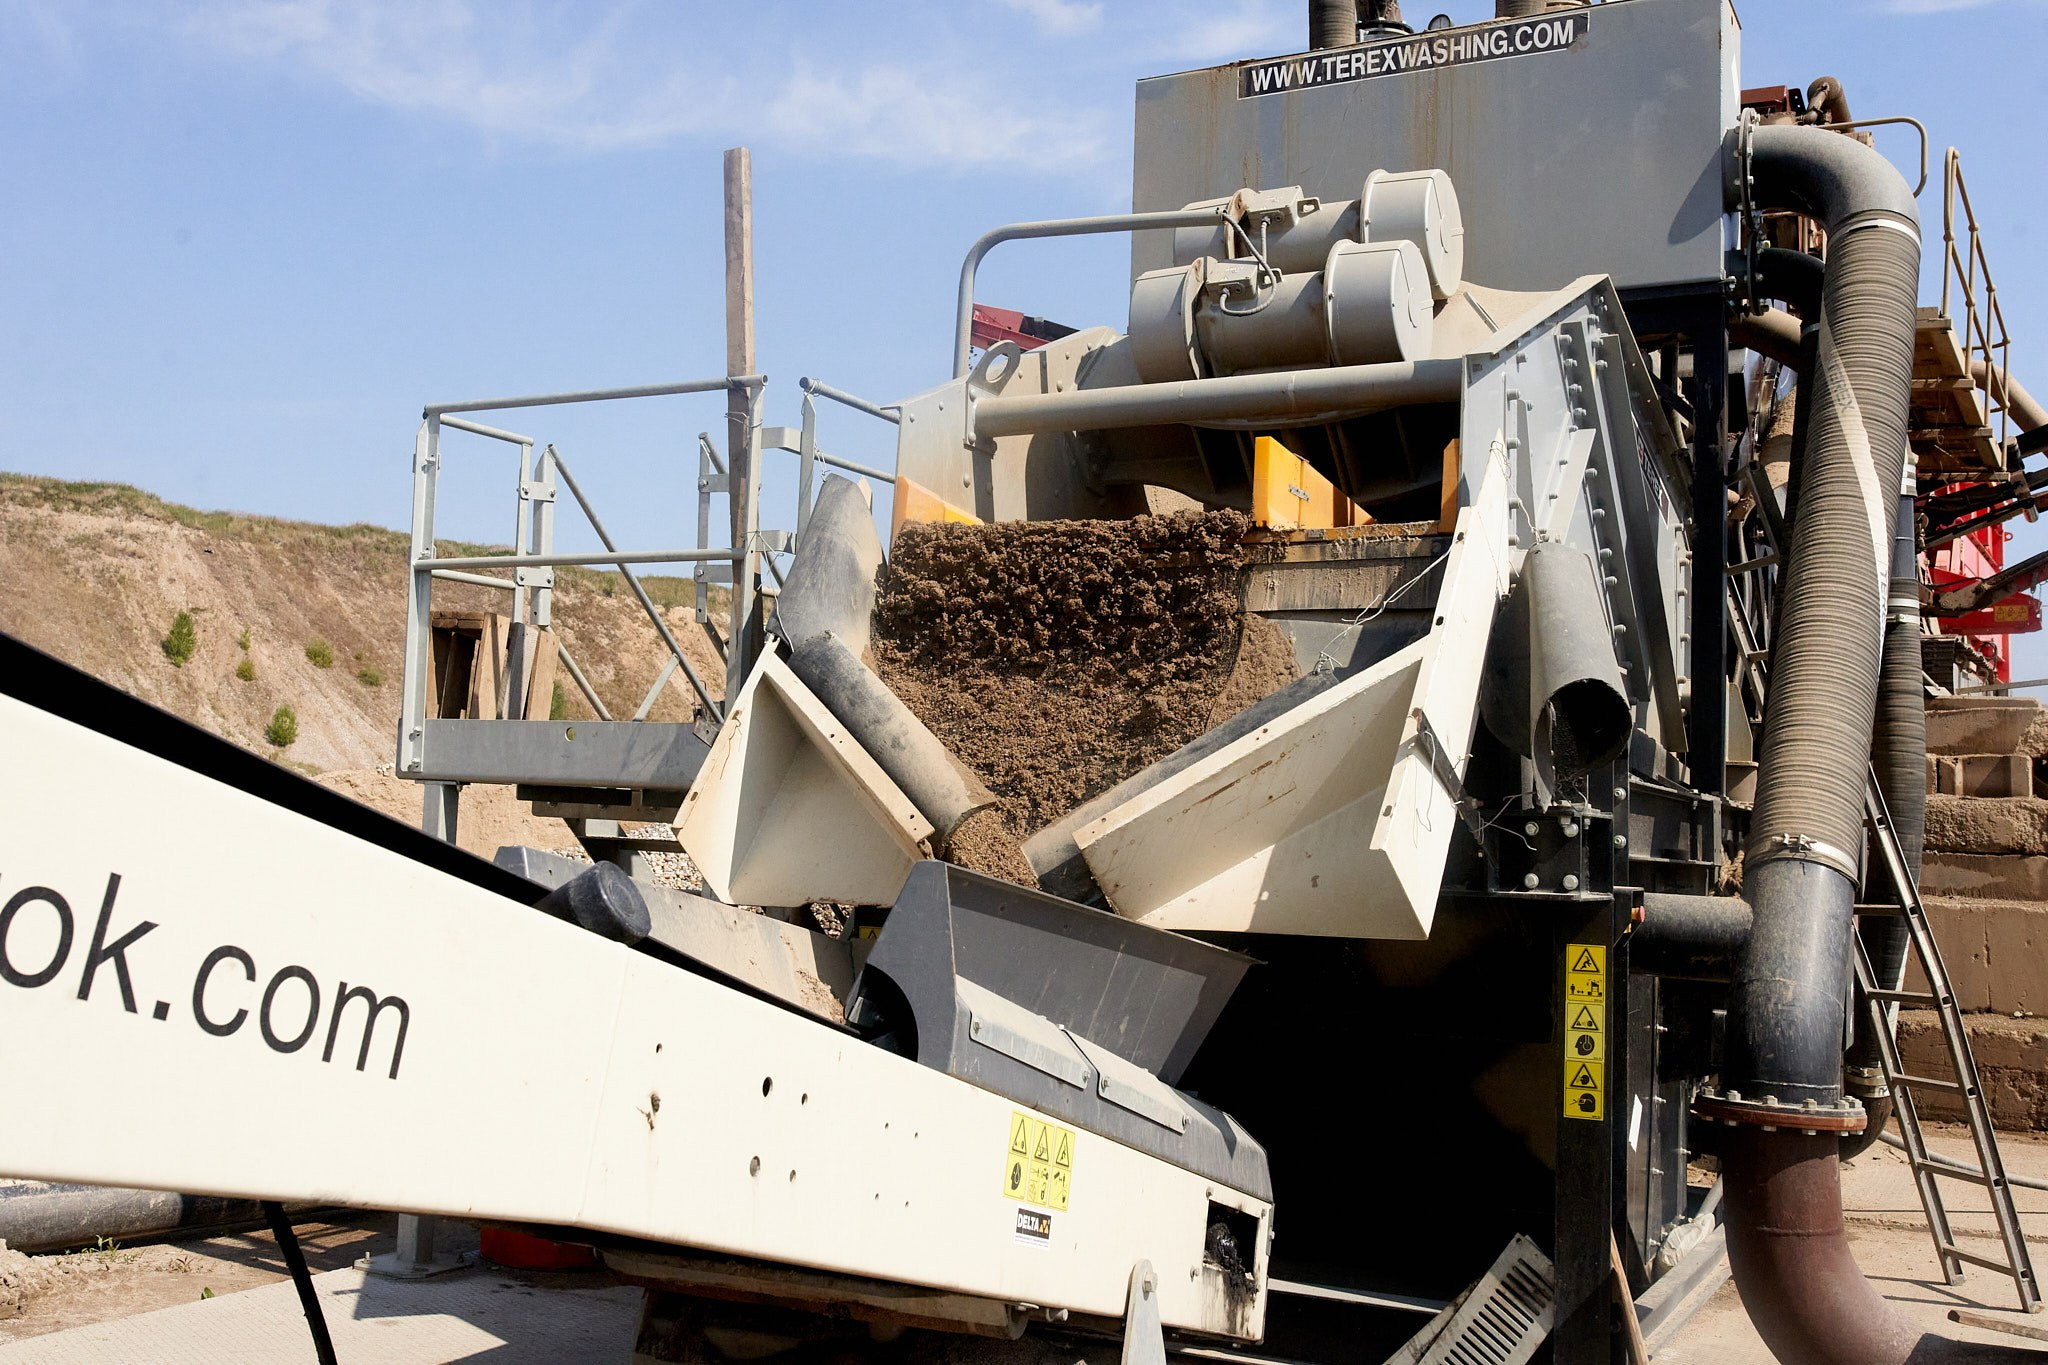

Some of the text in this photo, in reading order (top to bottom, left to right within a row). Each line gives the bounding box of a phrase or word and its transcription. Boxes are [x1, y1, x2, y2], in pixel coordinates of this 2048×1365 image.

[1251, 19, 1574, 92] WWW.TEREXWASHING.COM
[0, 872, 410, 1080] ok.com
[1017, 1213, 1040, 1232] DELTA
